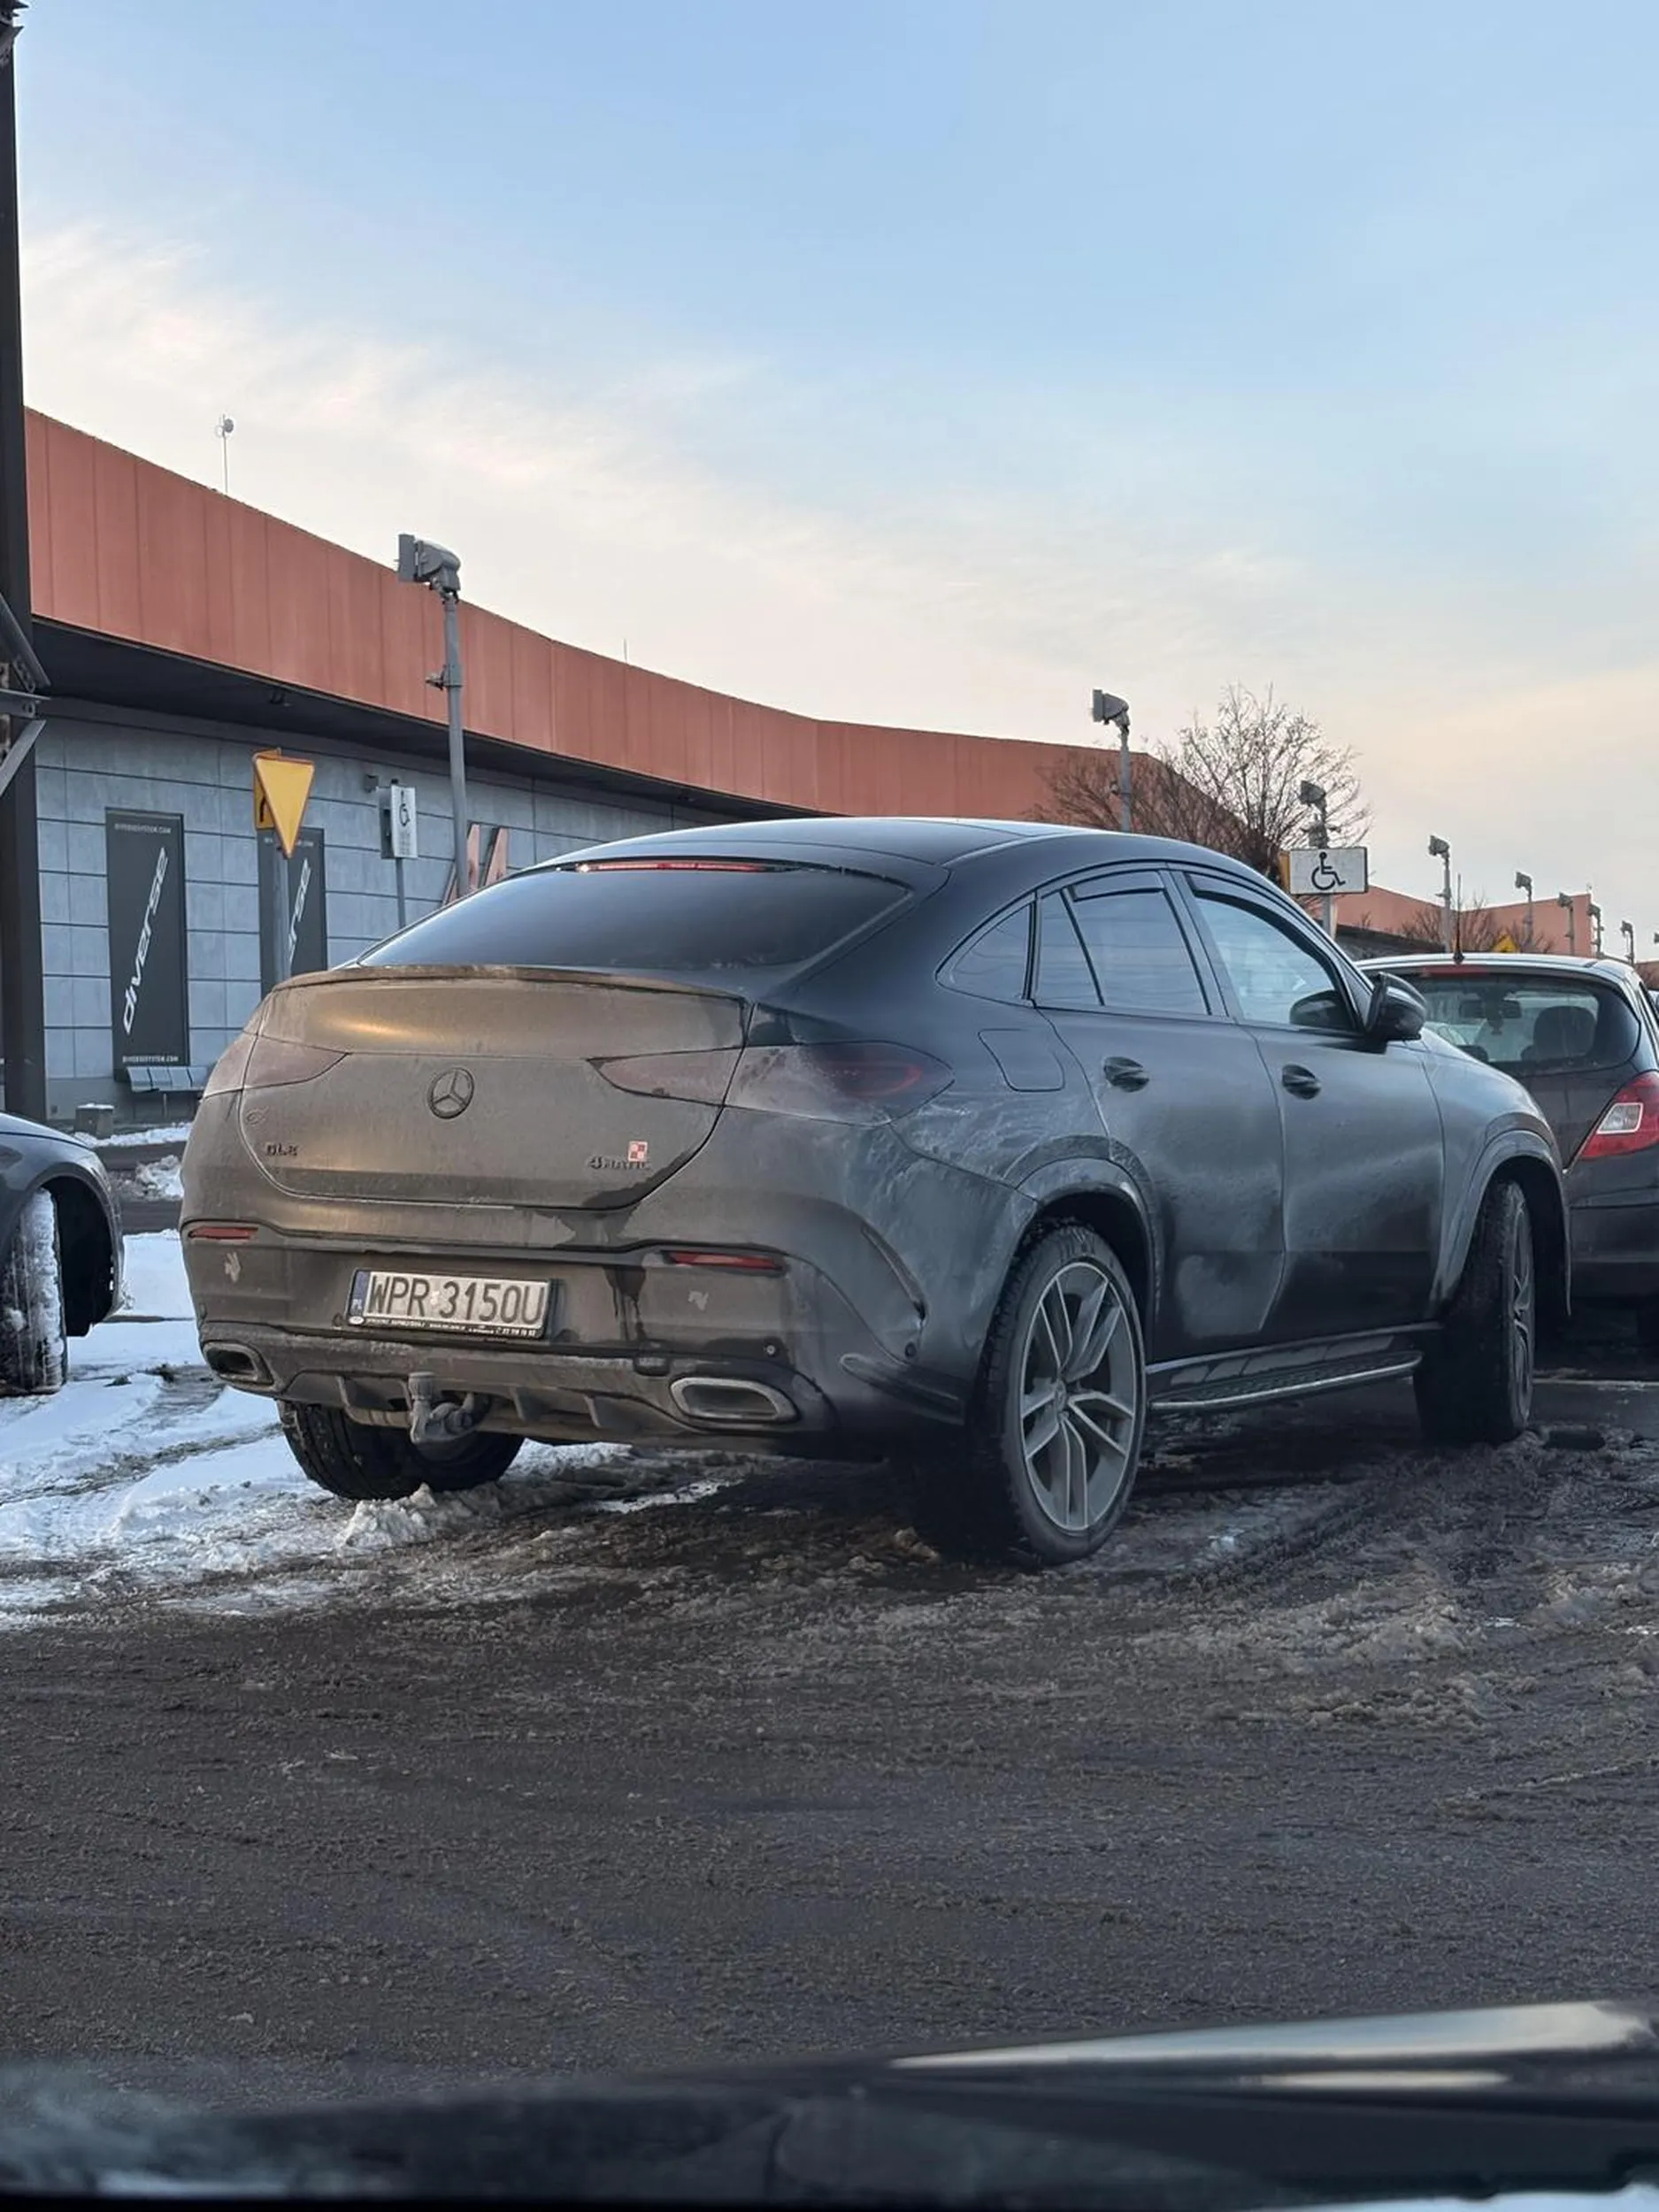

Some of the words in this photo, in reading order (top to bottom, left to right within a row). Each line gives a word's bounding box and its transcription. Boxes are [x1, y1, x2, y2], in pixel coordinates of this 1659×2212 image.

[123, 847, 168, 1035] diverse
[367, 1275, 430, 1317] WPR
[439, 1279, 545, 1325] 3150U
